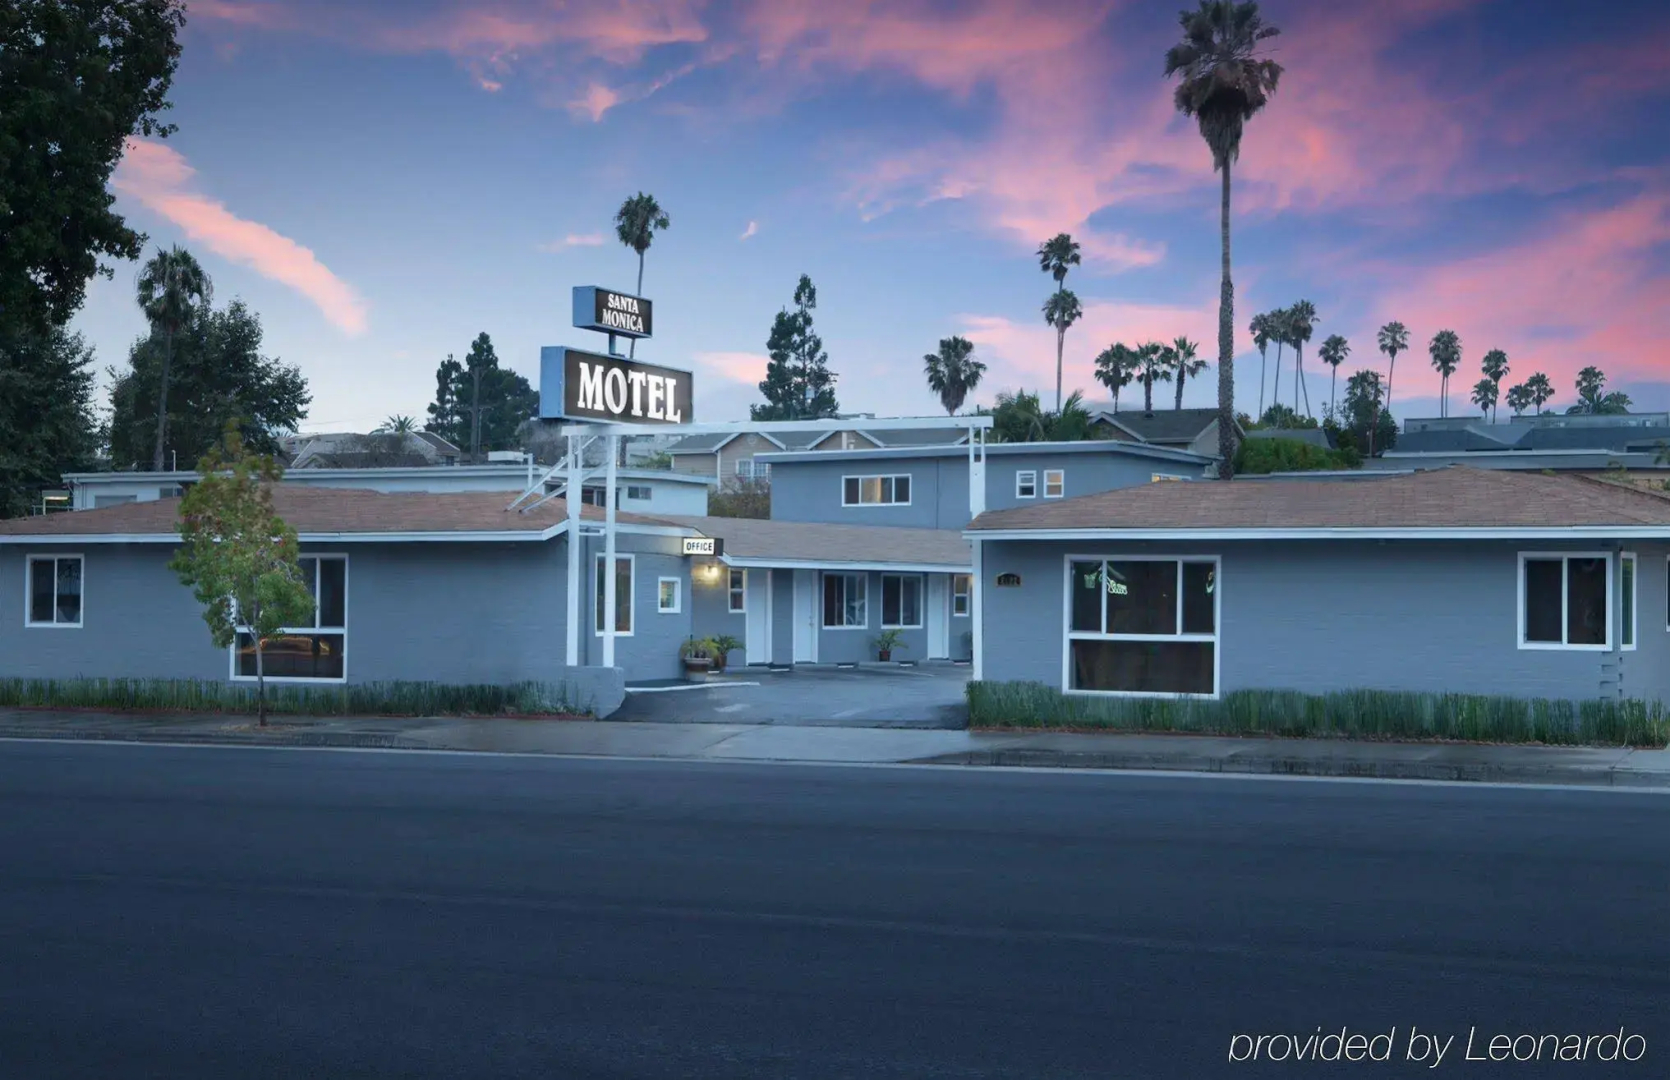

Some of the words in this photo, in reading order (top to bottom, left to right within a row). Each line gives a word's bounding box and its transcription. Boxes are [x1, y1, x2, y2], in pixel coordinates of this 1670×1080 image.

[607, 293, 640, 314] SANTA
[602, 308, 644, 333] MONICA
[577, 361, 681, 424] MOTEL
[686, 541, 713, 552] OFFICE
